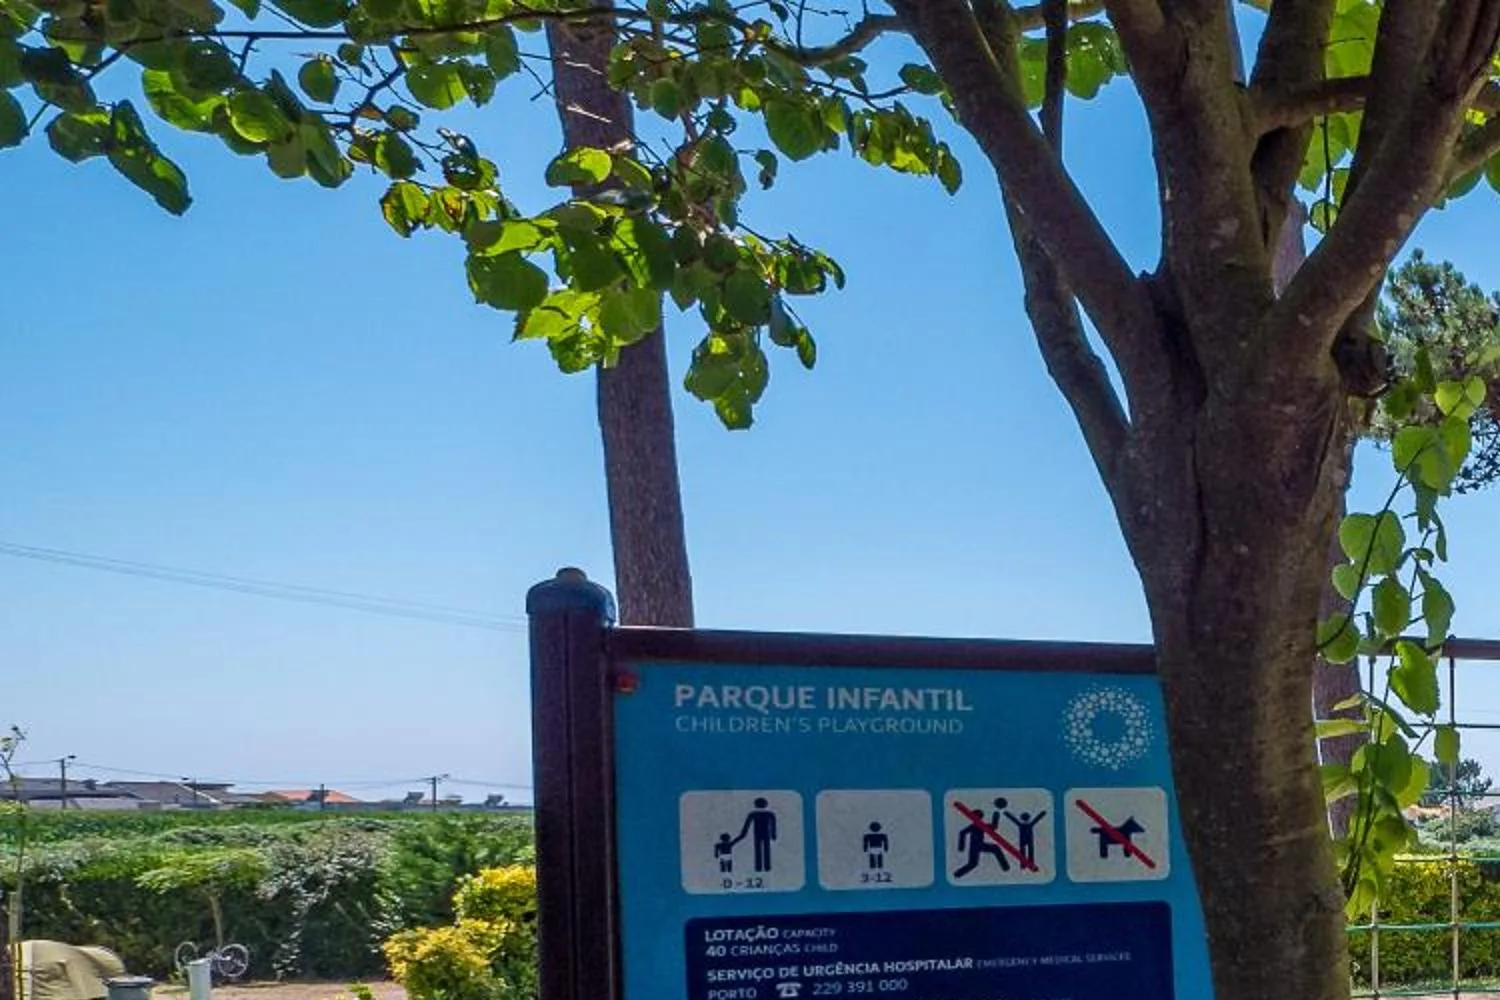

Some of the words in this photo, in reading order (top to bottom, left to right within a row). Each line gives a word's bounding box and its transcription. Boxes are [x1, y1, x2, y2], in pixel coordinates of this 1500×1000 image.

[675, 684, 816, 714] PARQUE
[827, 686, 974, 712] INFANTIL
[675, 714, 812, 734] CHILDREN'S
[818, 716, 964, 735] PLAYGROUND
[704, 925, 779, 943] LOTAÇÃO
[704, 945, 726, 957] 40
[730, 943, 801, 957] CRIANÇAS
[706, 967, 775, 982] SERVIÇO
[778, 965, 800, 979] DE
[803, 961, 880, 978] URGÊNCIA
[883, 956, 973, 974] HOSPITALAR
[707, 986, 757, 1000] PORTO
[812, 981, 843, 996] 229
[847, 979, 875, 993] 391
[878, 977, 909, 992] 000
